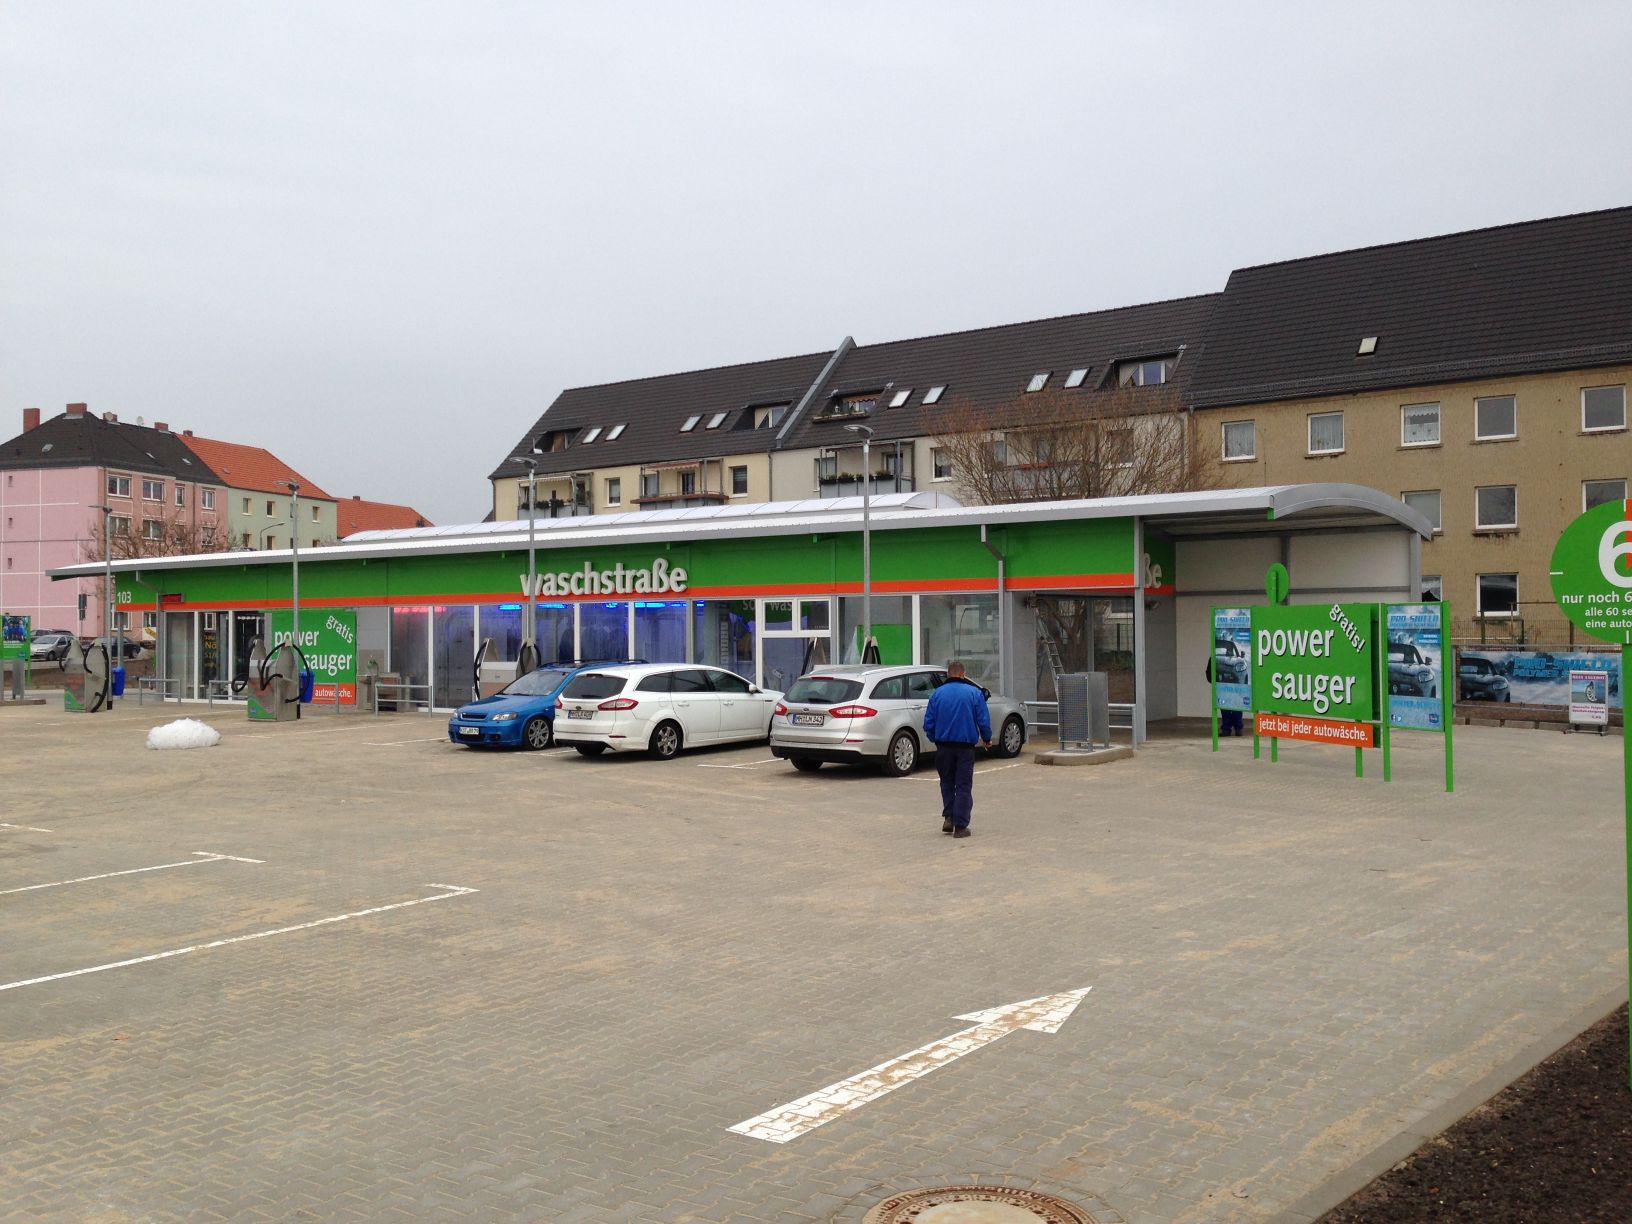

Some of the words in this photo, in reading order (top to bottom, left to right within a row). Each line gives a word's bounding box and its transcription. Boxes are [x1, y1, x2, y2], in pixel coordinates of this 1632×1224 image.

[520, 557, 688, 597] waschstraße
[117, 591, 132, 604] 103
[1562, 594, 1584, 603] nur
[1588, 591, 1619, 603] noch
[1585, 607, 1602, 616] alle
[1605, 607, 1619, 616] 60
[326, 615, 354, 644] gratis
[1328, 604, 1366, 653] gratis!
[1585, 619, 1607, 628] eine
[1258, 628, 1335, 666] power
[303, 653, 352, 676] sauger
[1272, 671, 1356, 714] sauger
[1259, 718, 1276, 733] jetzt
[1278, 719, 1290, 732] bei
[1291, 720, 1312, 736] jeder
[1313, 724, 1368, 741] autowäsche.
